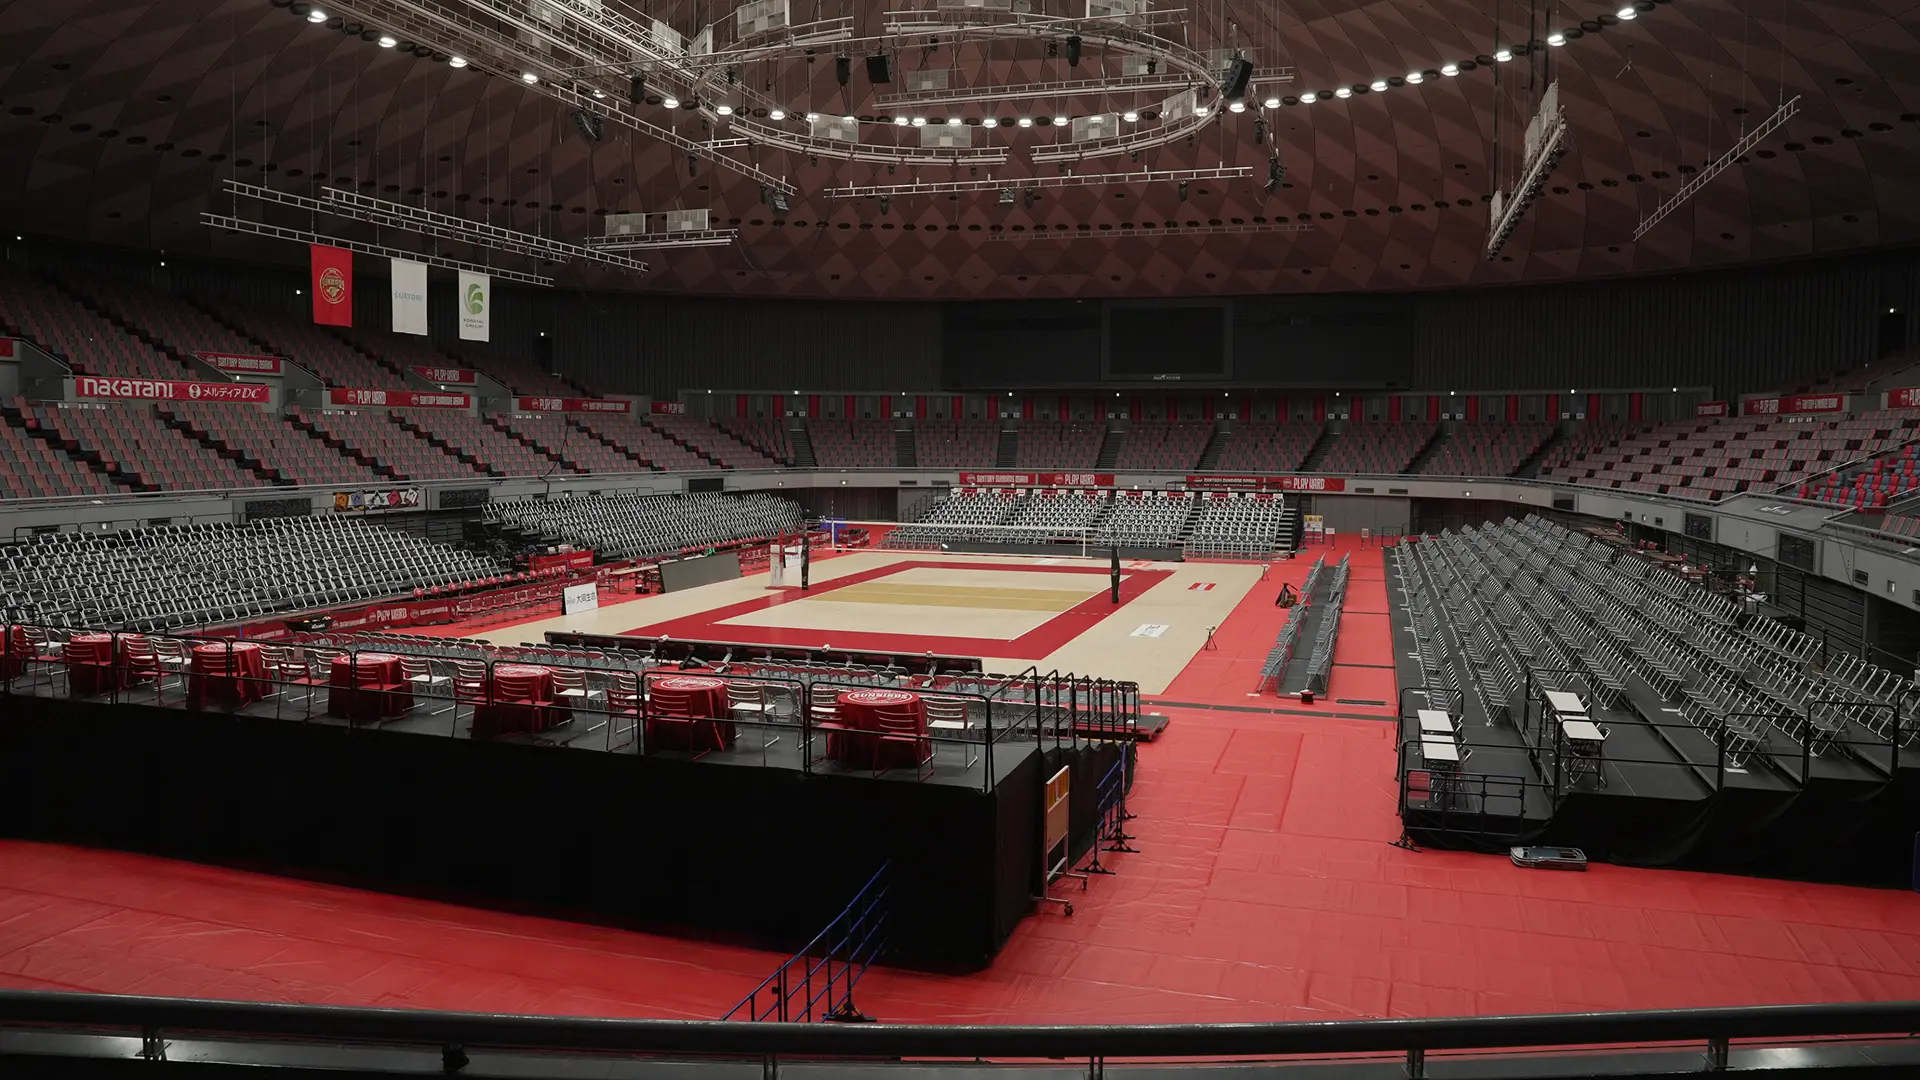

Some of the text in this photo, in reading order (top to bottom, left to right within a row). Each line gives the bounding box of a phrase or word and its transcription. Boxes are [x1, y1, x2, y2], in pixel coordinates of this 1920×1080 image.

[357, 390, 371, 404] PLAY
[1064, 474, 1079, 485] PLAY
[1293, 477, 1308, 490] PLAY
[376, 609, 390, 622] PLAY
